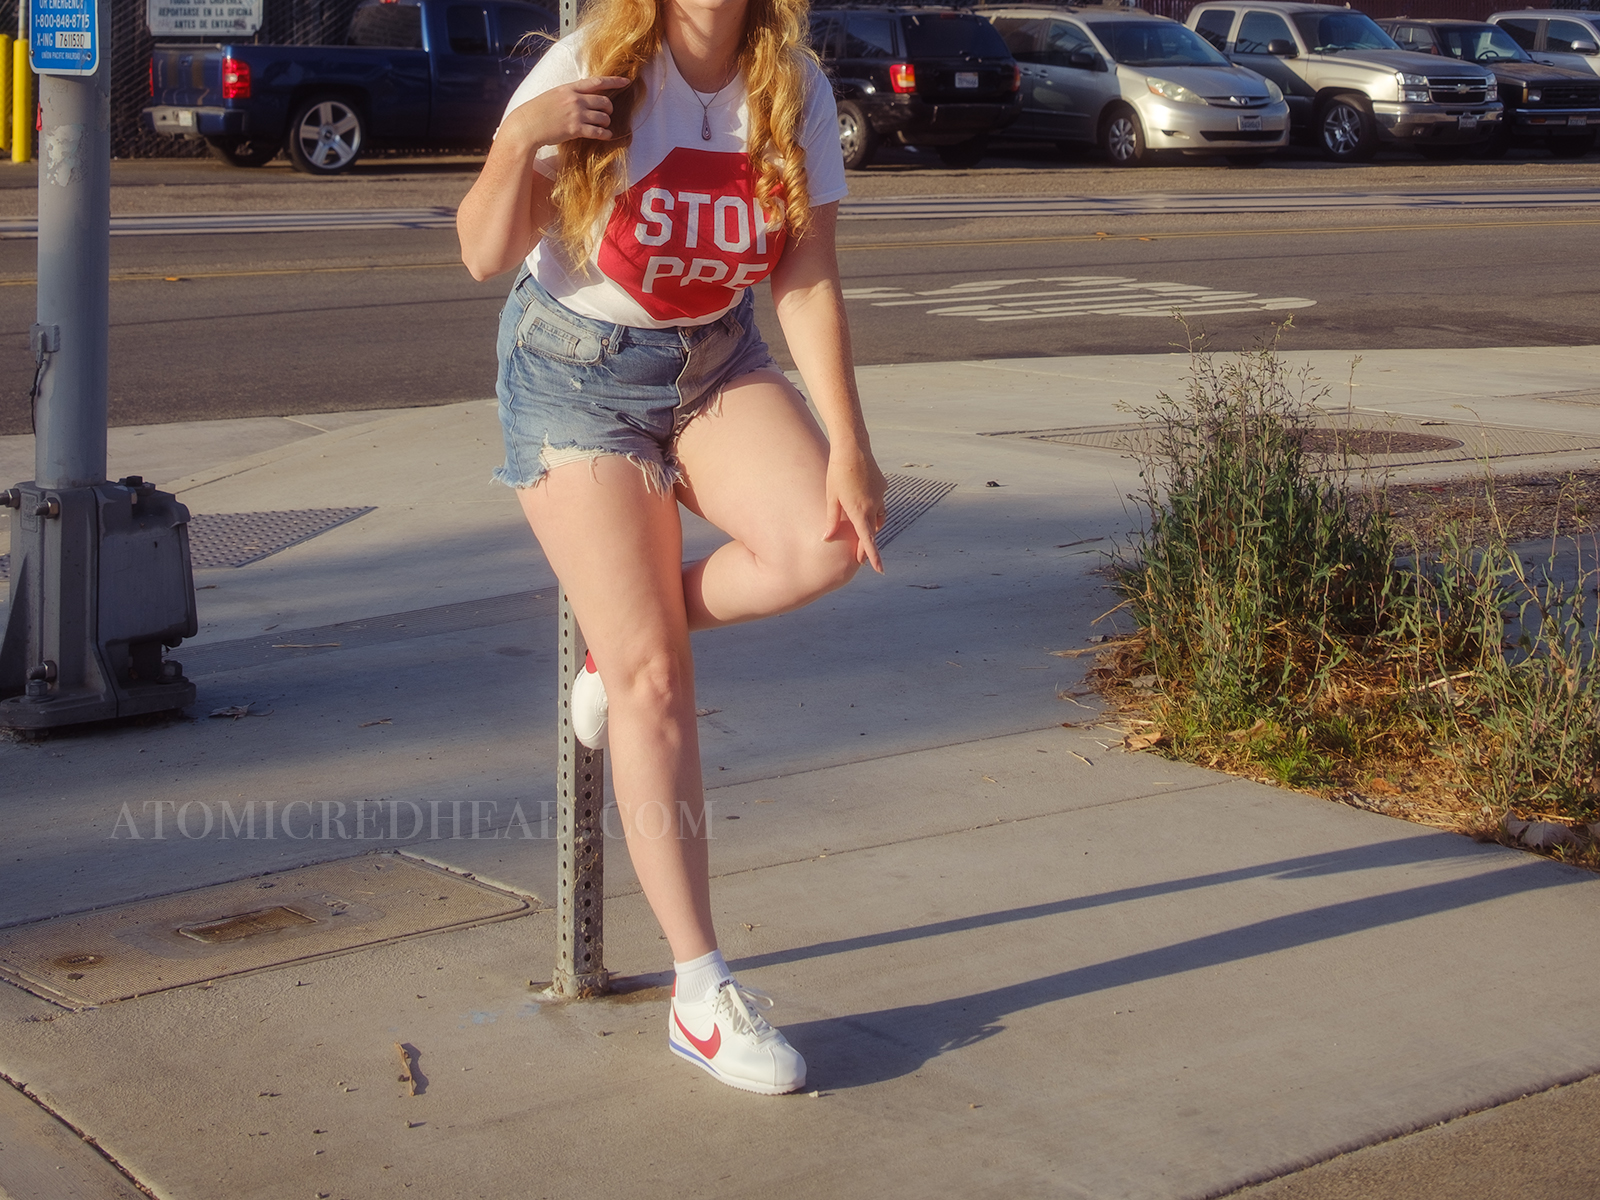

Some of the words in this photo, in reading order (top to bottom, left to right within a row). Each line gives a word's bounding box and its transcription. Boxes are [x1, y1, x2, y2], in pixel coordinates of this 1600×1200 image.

[158, 7, 199, 17] REPORTARSE
[203, 7, 212, 17] EN
[215, 7, 224, 17] LA
[227, 7, 253, 17] OFICINA
[35, 14, 90, 28] 1-800-848-8715
[174, 19, 196, 29] ANTES
[200, 19, 208, 29] DE
[36, 32, 53, 46] X-ING
[634, 187, 786, 255] STOP
